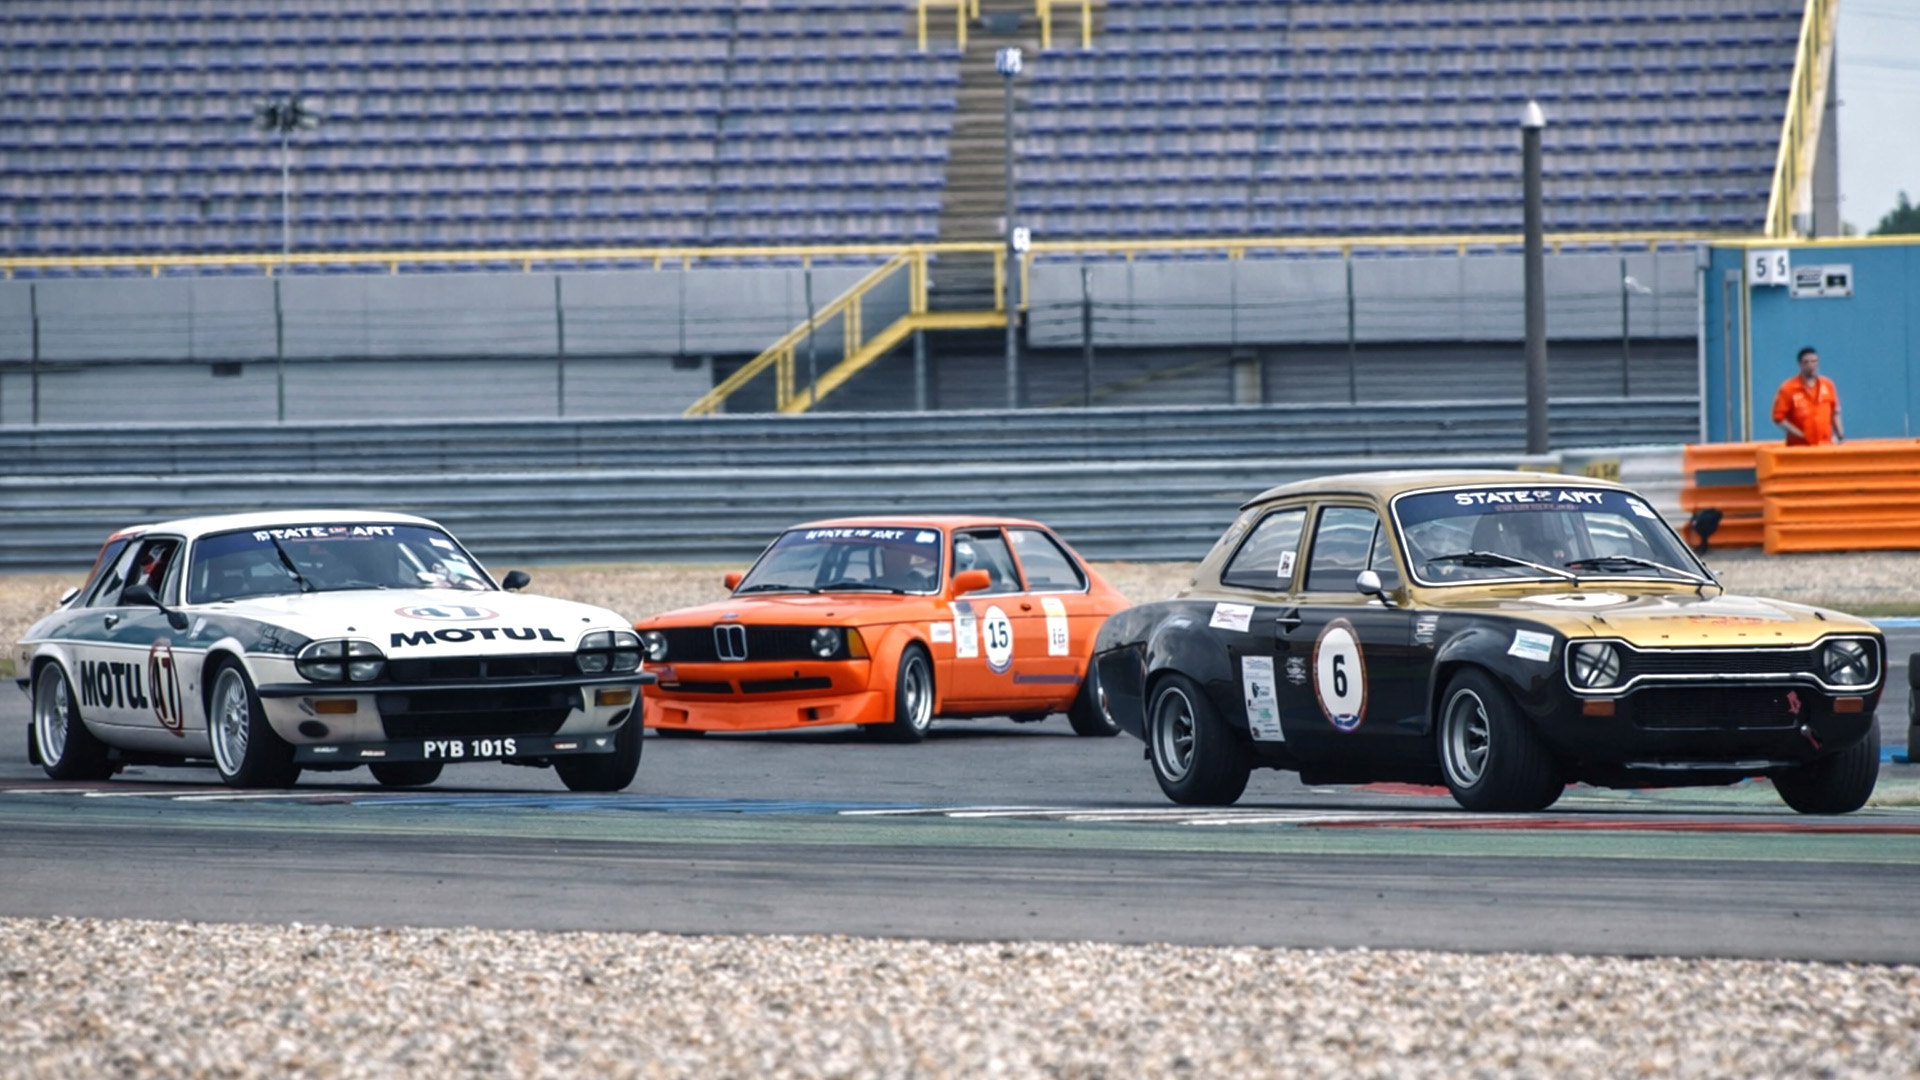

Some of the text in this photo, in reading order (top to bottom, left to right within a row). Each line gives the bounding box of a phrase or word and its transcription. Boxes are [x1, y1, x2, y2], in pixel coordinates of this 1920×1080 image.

[1756, 257, 1766, 278] 5
[1454, 491, 1532, 505] STATE
[352, 526, 396, 537] ART
[390, 627, 566, 648] MOTUL
[988, 621, 1009, 649] 15
[1332, 654, 1349, 698] 6
[424, 737, 517, 759] PYB 101S
